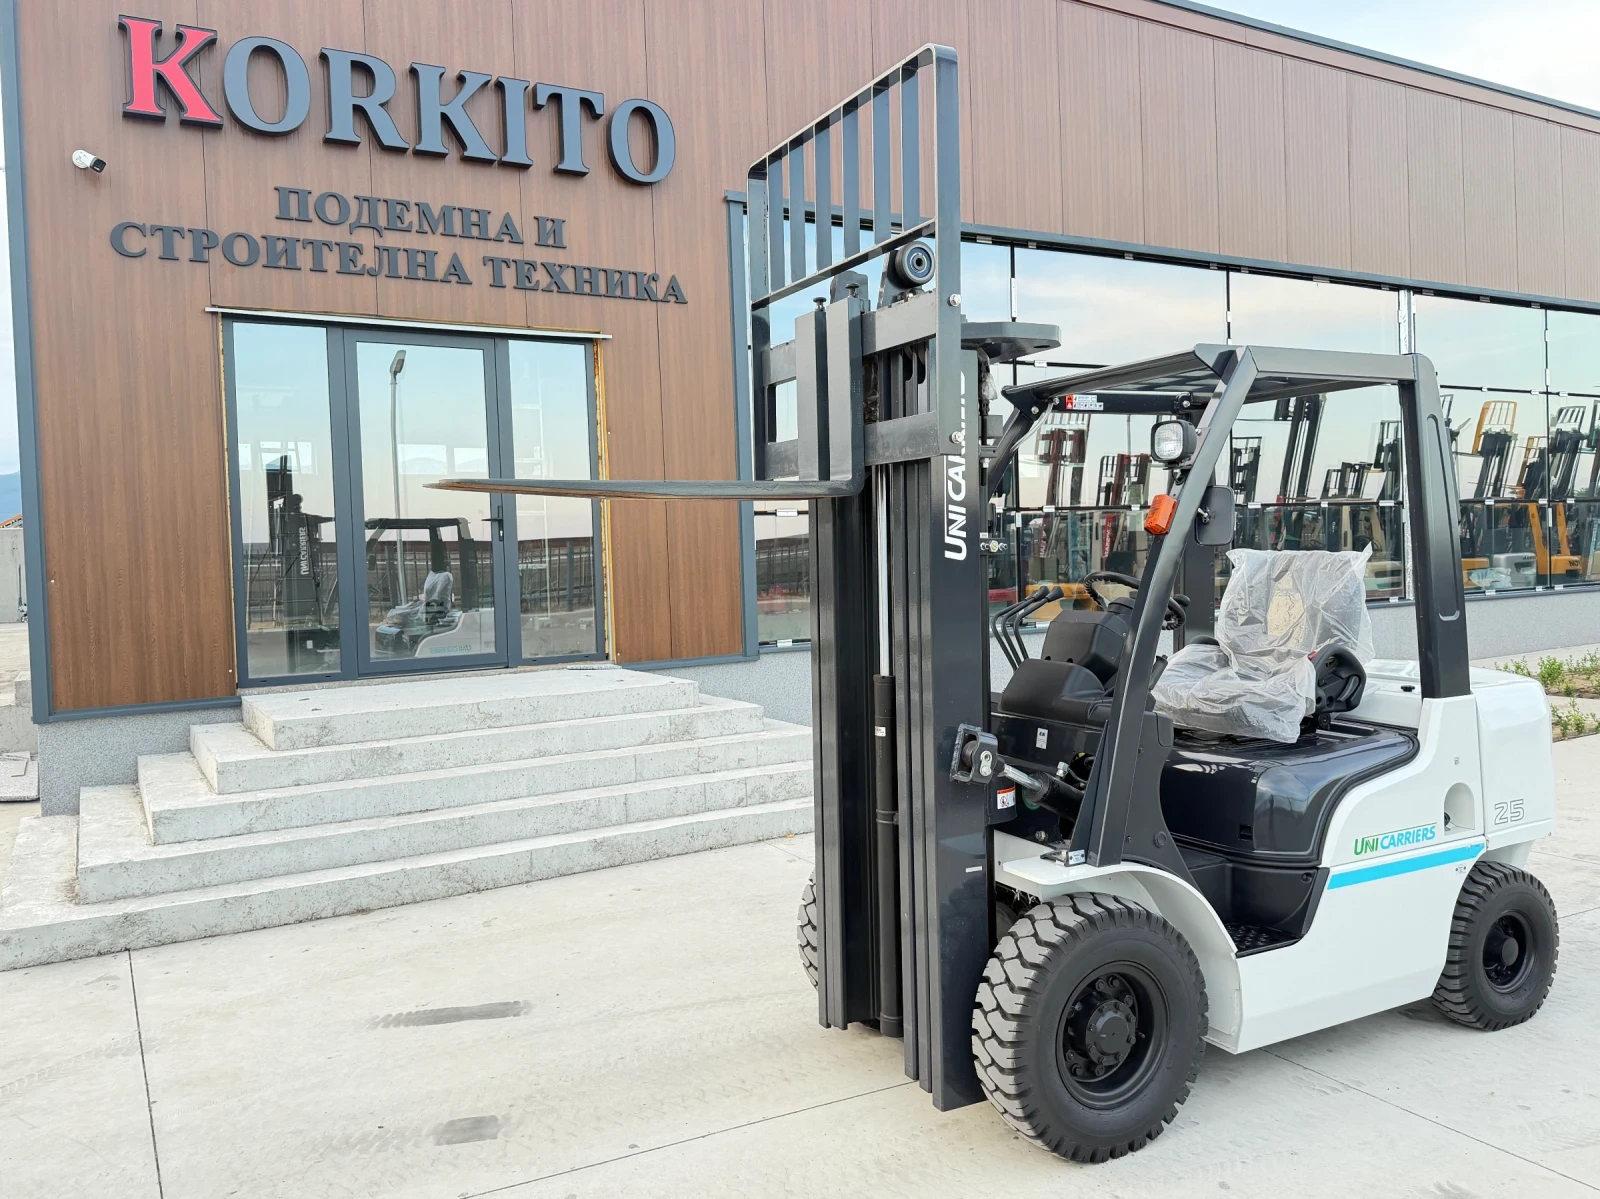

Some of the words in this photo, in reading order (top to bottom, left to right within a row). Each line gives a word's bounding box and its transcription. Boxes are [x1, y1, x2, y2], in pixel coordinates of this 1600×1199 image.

[118, 14, 676, 186] KORKITO
[274, 186, 524, 244] ПОДЕМНА
[535, 216, 567, 249] И
[110, 221, 472, 285] СТРОИТЕЛНА
[483, 255, 688, 305] ТЕХНИКА
[1494, 800, 1525, 825] 25
